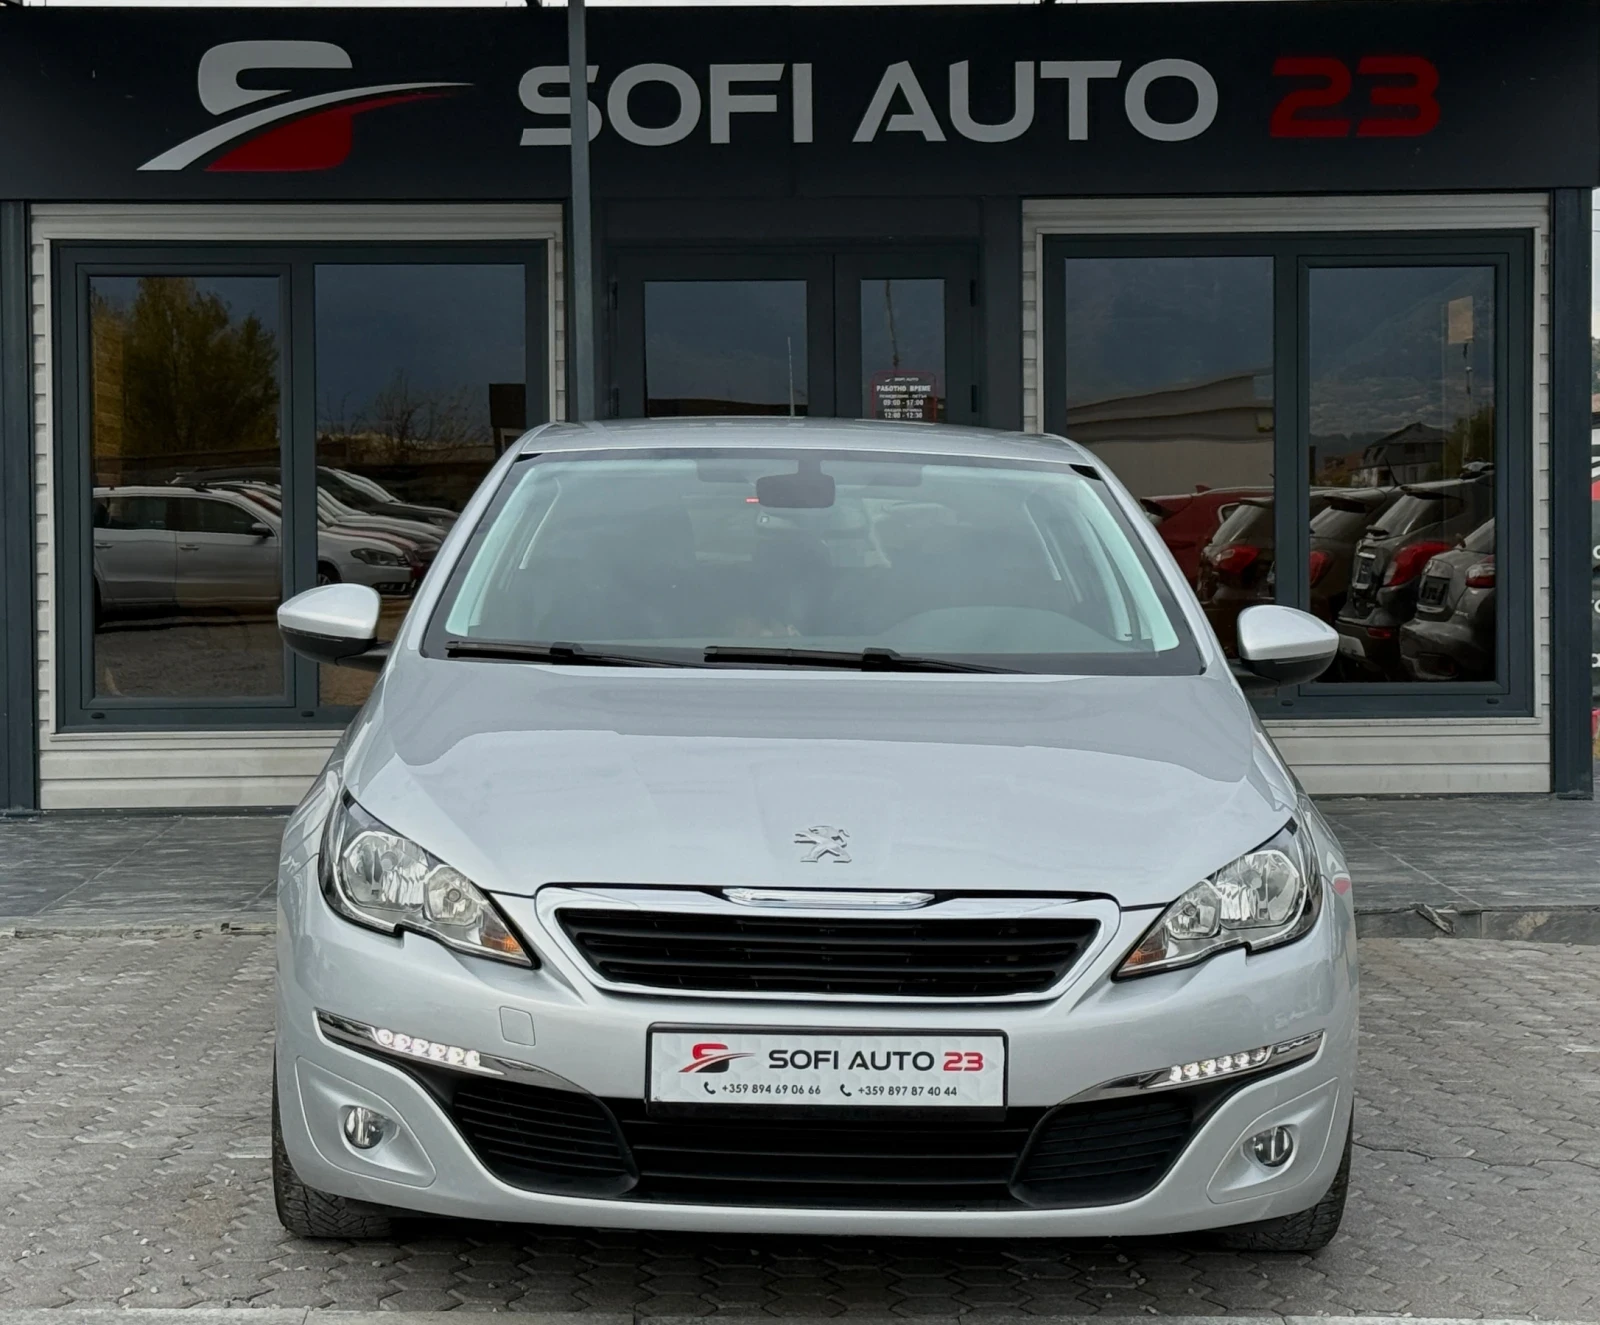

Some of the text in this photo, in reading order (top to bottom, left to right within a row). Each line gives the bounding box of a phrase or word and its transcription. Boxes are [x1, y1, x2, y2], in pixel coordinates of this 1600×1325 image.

[518, 56, 1441, 146] SOFI AUTO 23
[768, 1049, 984, 1072] SOFI AUTO 23
[722, 1083, 821, 1095] +359 894 69 06 66
[858, 1085, 957, 1097] +359 897 87 40 44
